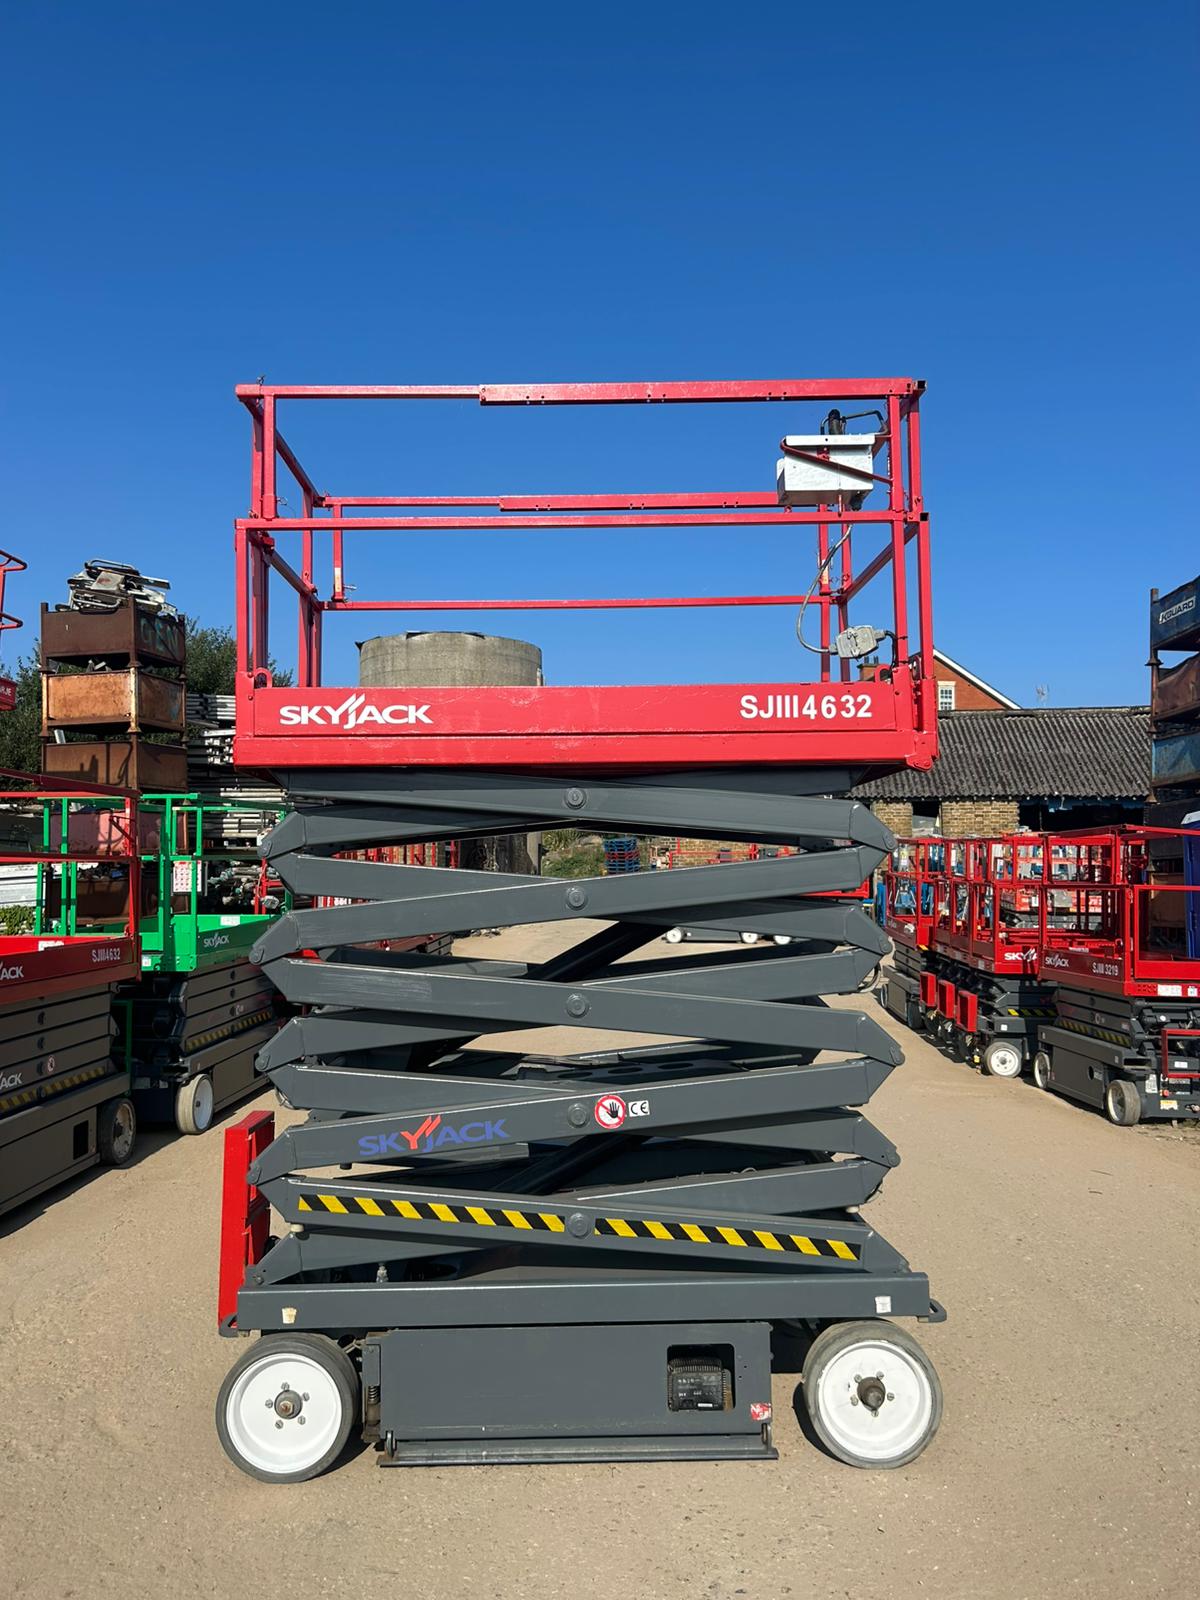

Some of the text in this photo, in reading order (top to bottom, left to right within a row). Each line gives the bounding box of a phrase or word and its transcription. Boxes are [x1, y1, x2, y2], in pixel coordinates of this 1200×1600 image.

[279, 693, 434, 729] SKYJACK
[203, 932, 230, 948] SKYJACK
[1045, 954, 1070, 968] SKYJACK
[630, 1101, 649, 1115] CE
[358, 1114, 510, 1156] SKYJACK
